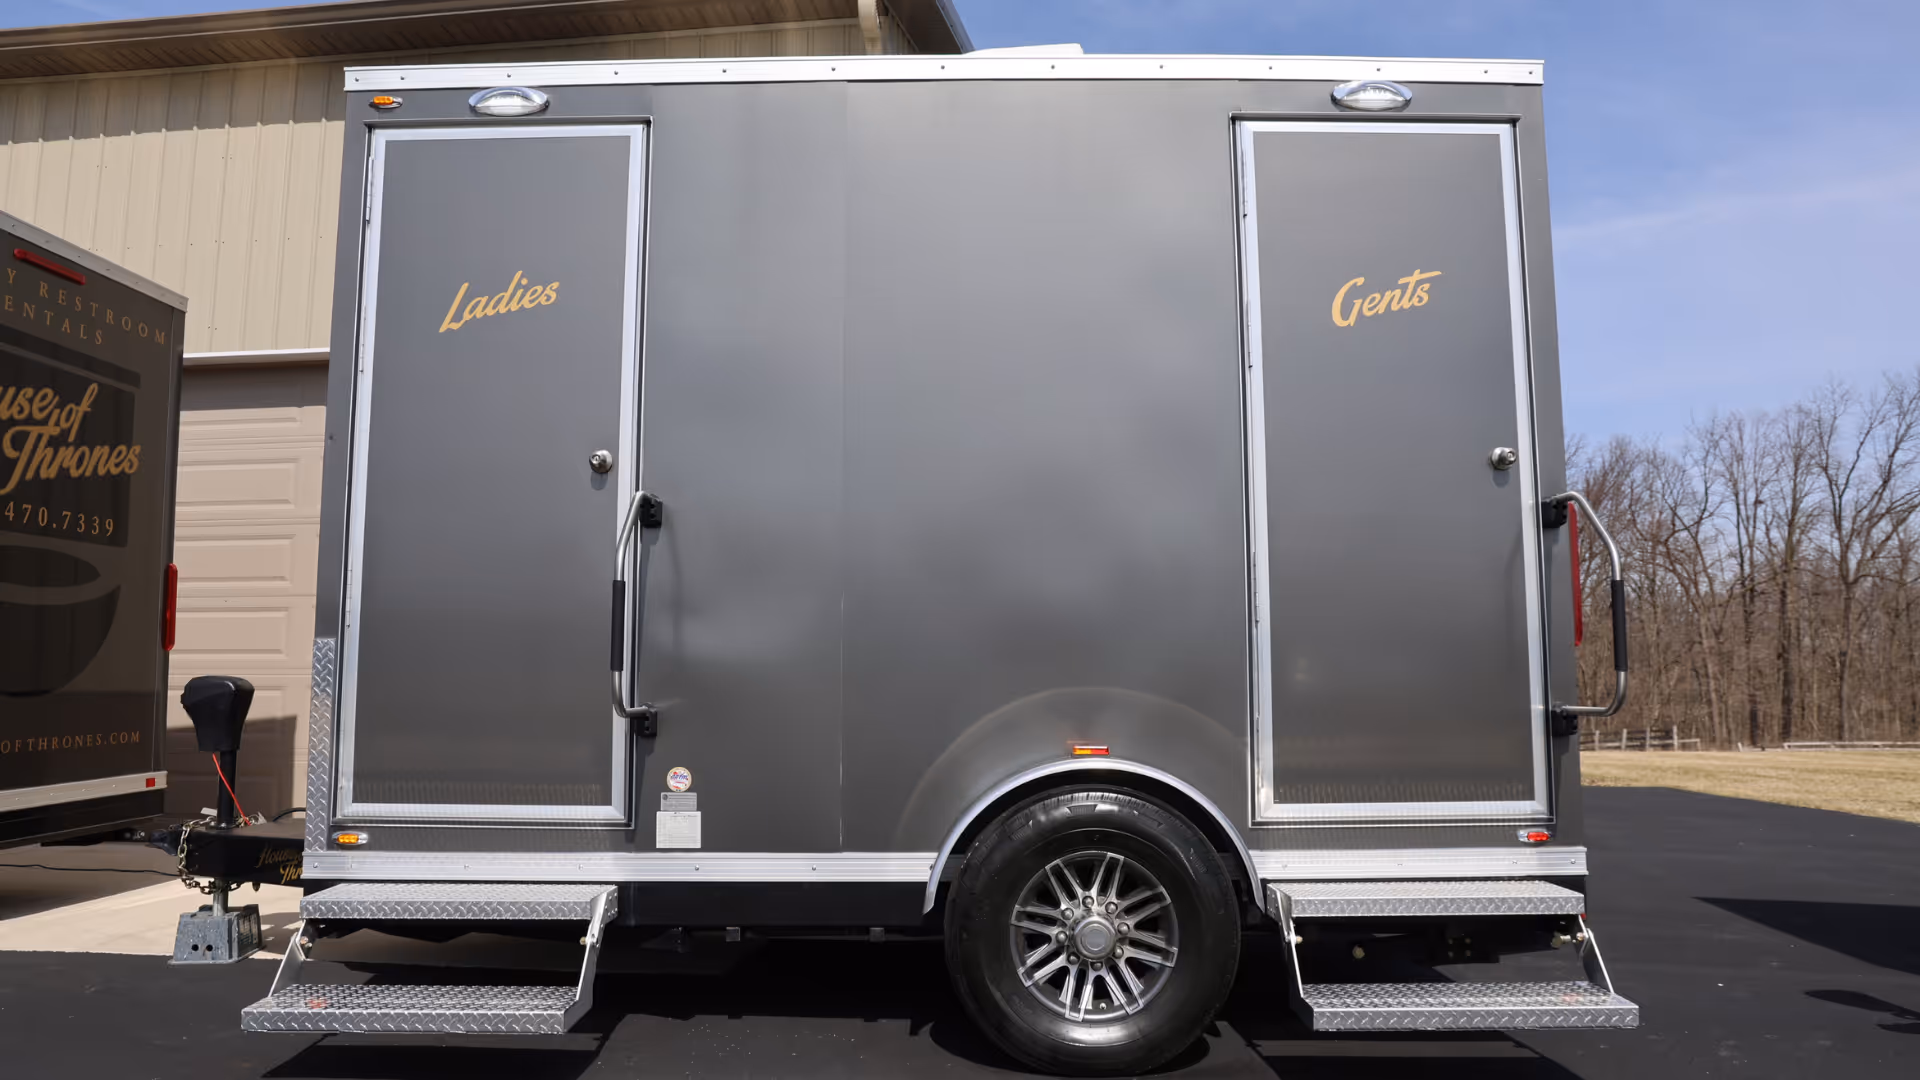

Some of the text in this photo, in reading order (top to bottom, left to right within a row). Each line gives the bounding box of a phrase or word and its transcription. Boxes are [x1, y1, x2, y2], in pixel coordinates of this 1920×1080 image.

[4, 295, 103, 345] ENTALS
[39, 281, 166, 345] RESTROOM
[438, 270, 560, 333] Ladies
[1331, 269, 1442, 327] Gents
[59, 383, 99, 442] of
[0, 408, 141, 495] Thrones
[4, 501, 114, 537] 470.7339
